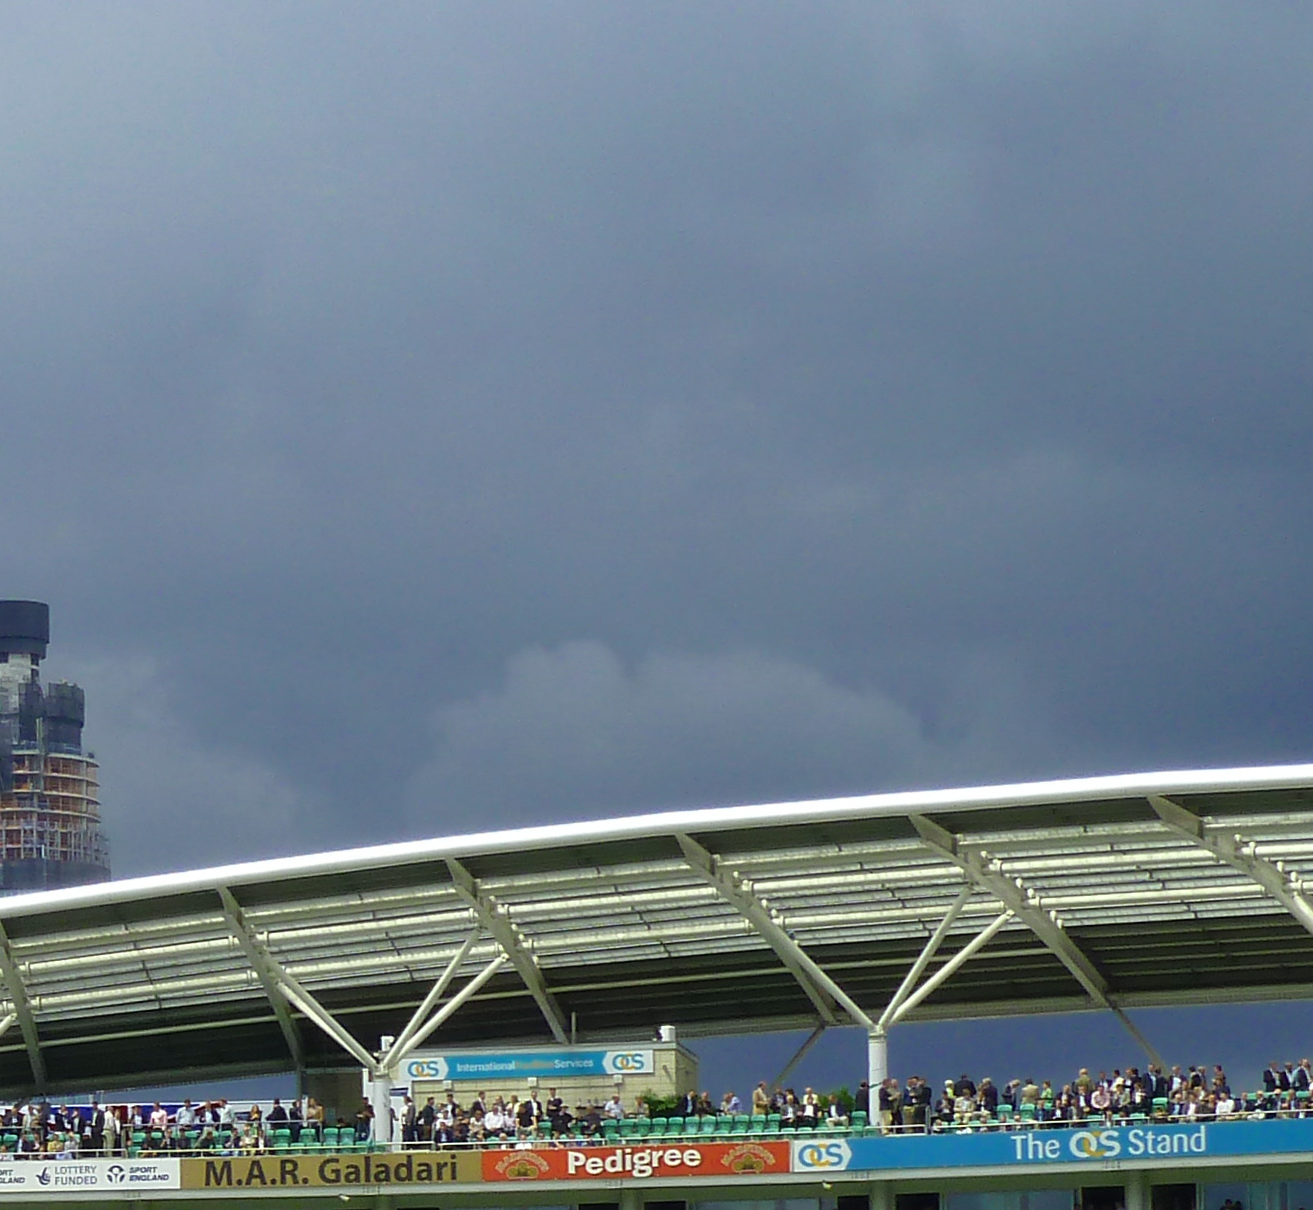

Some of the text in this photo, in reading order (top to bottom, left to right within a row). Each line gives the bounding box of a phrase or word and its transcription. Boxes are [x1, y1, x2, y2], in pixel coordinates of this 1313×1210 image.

[408, 1059, 439, 1077] OCS
[457, 1061, 515, 1073] International
[554, 1059, 593, 1069] Services
[612, 1053, 644, 1071] OCS
[1010, 1125, 1207, 1159] The OCS Stand
[567, 1149, 702, 1177] Pedigree
[798, 1143, 845, 1167] OCS
[55, 1164, 97, 1174] LOTTERY
[129, 1164, 158, 1172] SPORT
[129, 1172, 170, 1181] ENGLAND
[204, 1154, 458, 1187] M.A.R. Galadari
[55, 1174, 98, 1184] FUNDED
